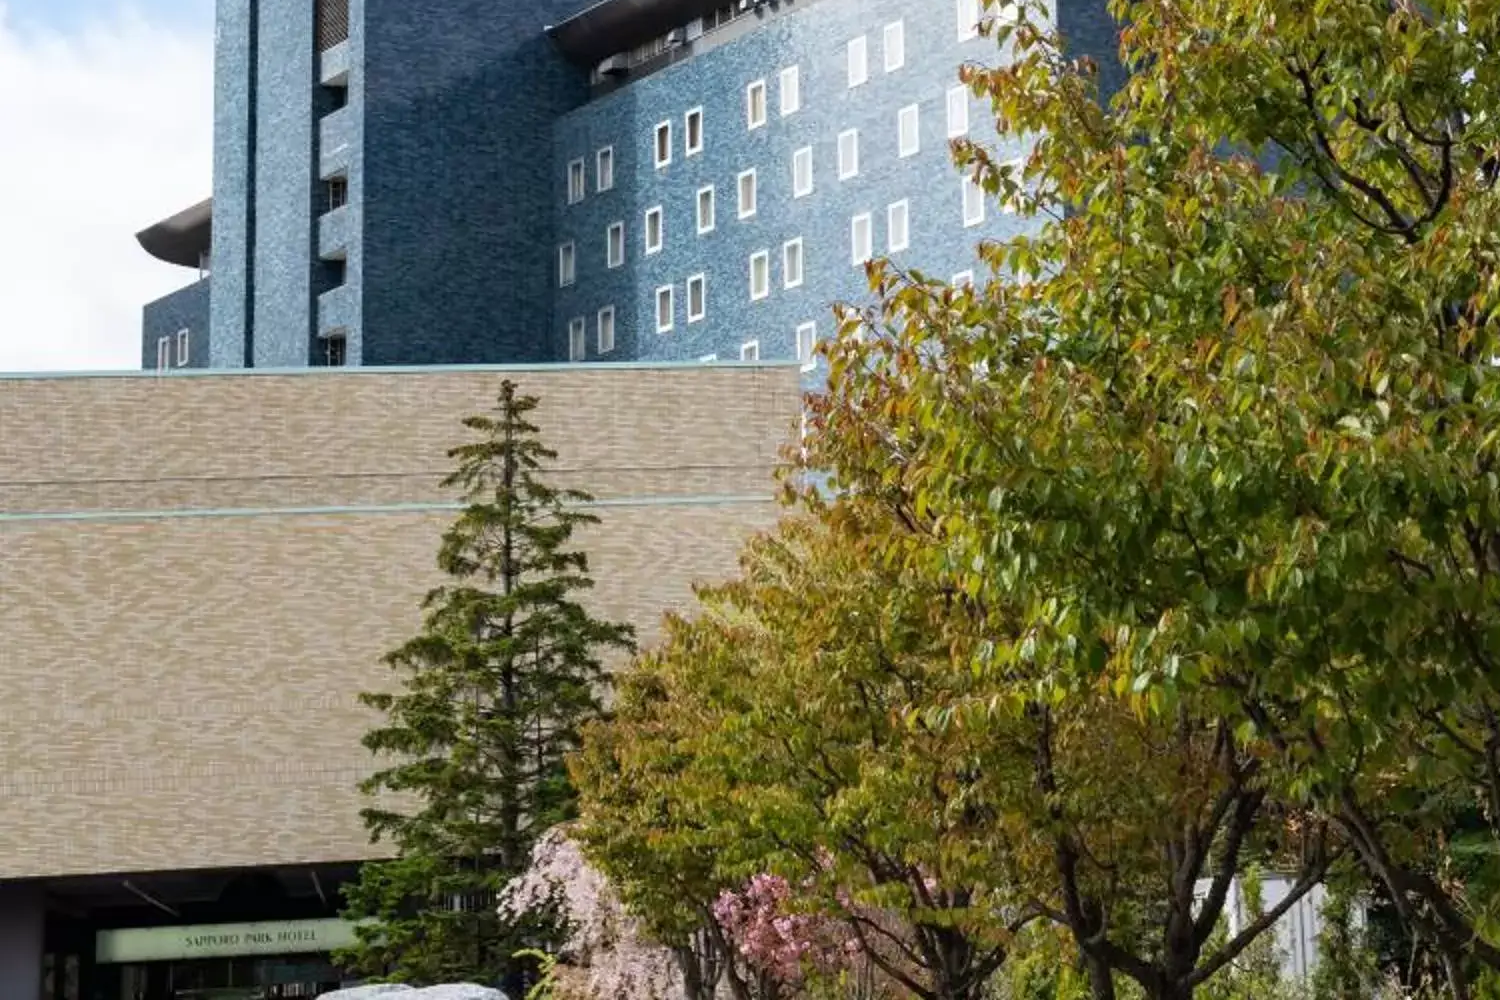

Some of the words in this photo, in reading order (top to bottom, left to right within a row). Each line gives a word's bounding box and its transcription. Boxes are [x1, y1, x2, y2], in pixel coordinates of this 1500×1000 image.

[185, 934, 239, 948] SAPPORO
[244, 932, 273, 944] PARK
[277, 929, 317, 942] HOTEL
